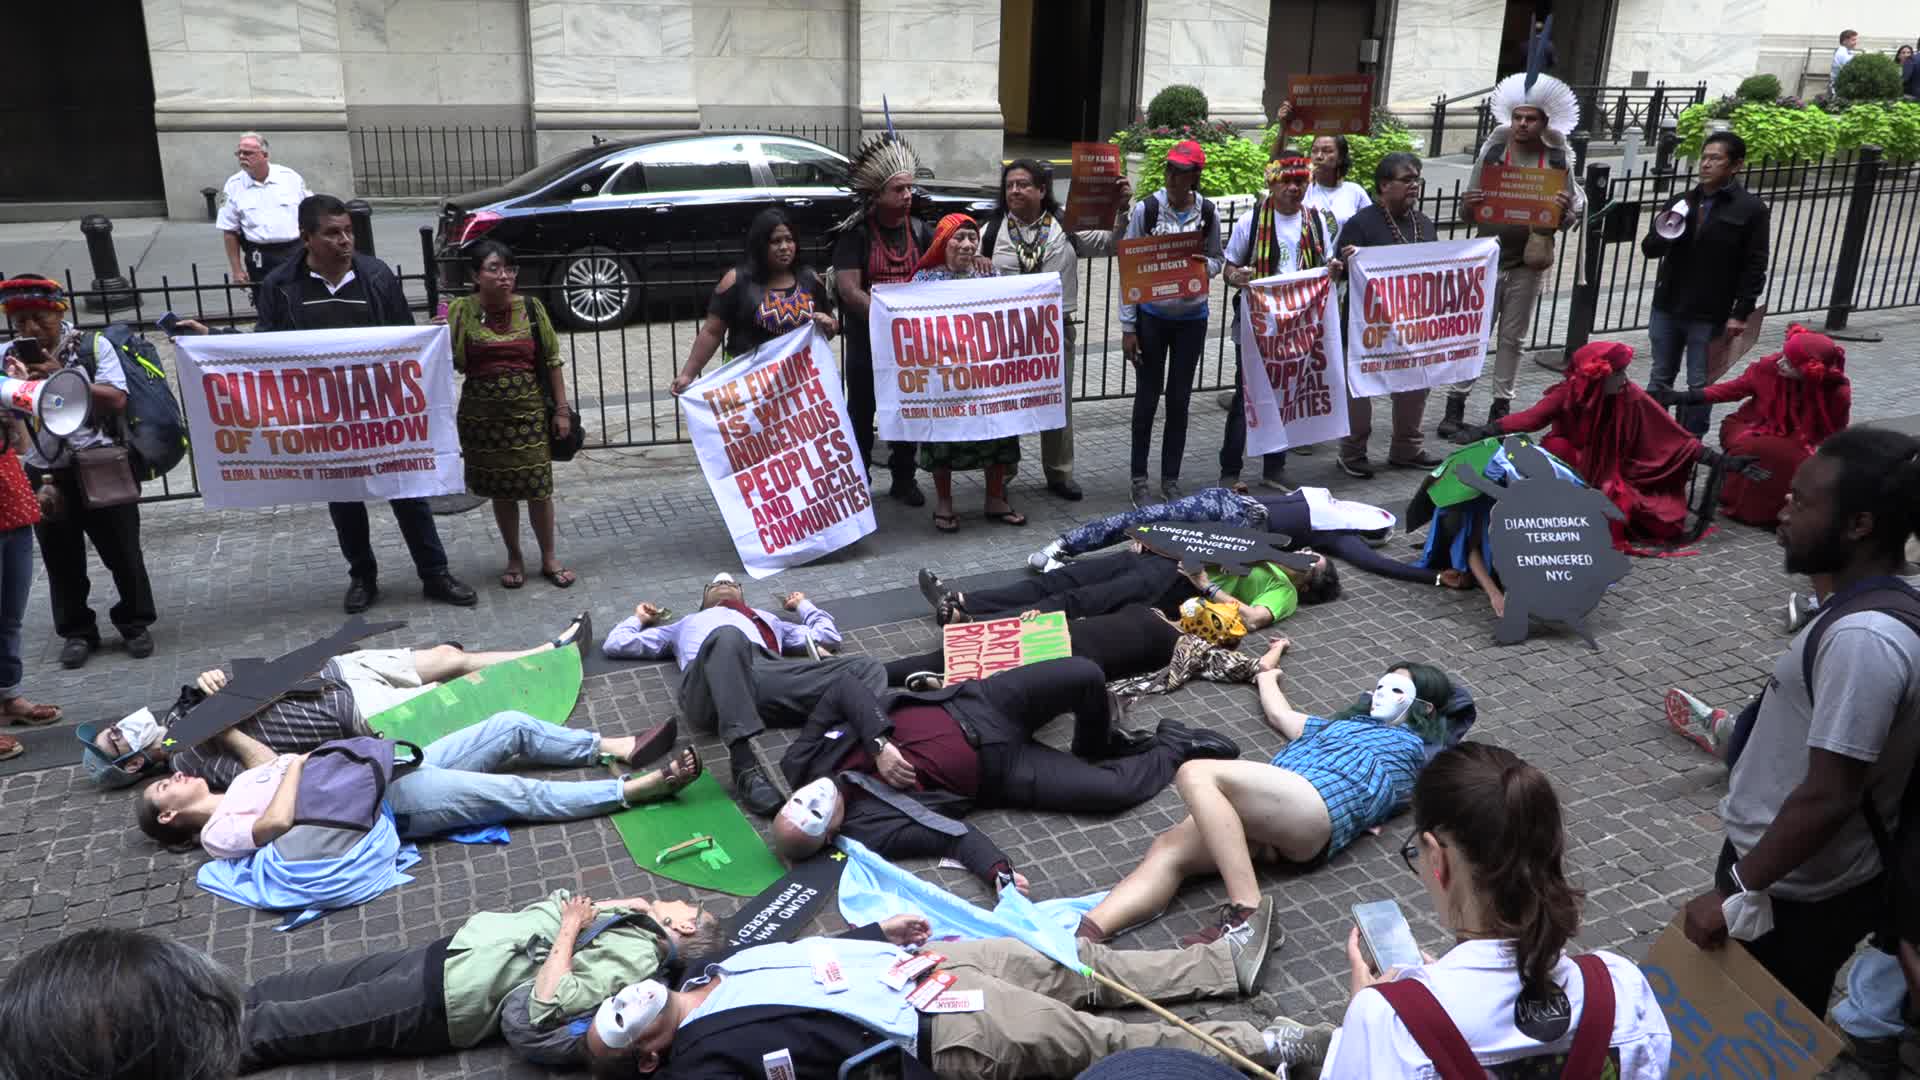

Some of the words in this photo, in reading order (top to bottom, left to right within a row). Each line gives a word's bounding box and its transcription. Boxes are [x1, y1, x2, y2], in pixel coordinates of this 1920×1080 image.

[1160, 259, 1188, 271] RIGHTS
[1363, 266, 1486, 325] GUARDIANS
[891, 304, 1060, 368] GUARDIANS
[1362, 326, 1392, 350] OF
[1395, 311, 1484, 346] TOMORROW
[202, 360, 426, 428] GUARDIANS
[703, 381, 746, 420] THE
[744, 345, 820, 404] FUTURE
[897, 369, 930, 394] OF
[937, 354, 1060, 392] TOMORROW
[717, 414, 751, 444] IS
[752, 378, 826, 427] WITH
[901, 407, 930, 419] GLOBAL
[932, 404, 967, 418] ALLIANCE
[215, 428, 253, 454] OF
[261, 415, 428, 455] TOMORROW
[724, 400, 840, 473] INDIGENOUS
[221, 468, 256, 481] GLOBAL
[259, 467, 302, 480] ALLIANCE
[319, 464, 374, 479] TERRITORIAL
[376, 457, 436, 475] COMMUNITIES
[735, 429, 853, 508] PEOPLES
[751, 495, 794, 529] AND
[801, 464, 862, 505] LOCAL
[758, 482, 870, 554] COMMUNITIES
[1152, 525, 1204, 538] LONGEAR
[1209, 533, 1255, 546] SUNFISH
[1504, 517, 1590, 530] DIAMONDBACK
[1525, 532, 1580, 543] TERRAPIN
[1171, 535, 1248, 552] ENDANGERED
[1186, 545, 1215, 555] NYC
[1517, 554, 1593, 566] ENDANGERED
[1545, 570, 1573, 581] NYC
[982, 619, 1021, 670] EARTH
[738, 883, 803, 938] ENDANGERED
[778, 887, 818, 919] ROUND
